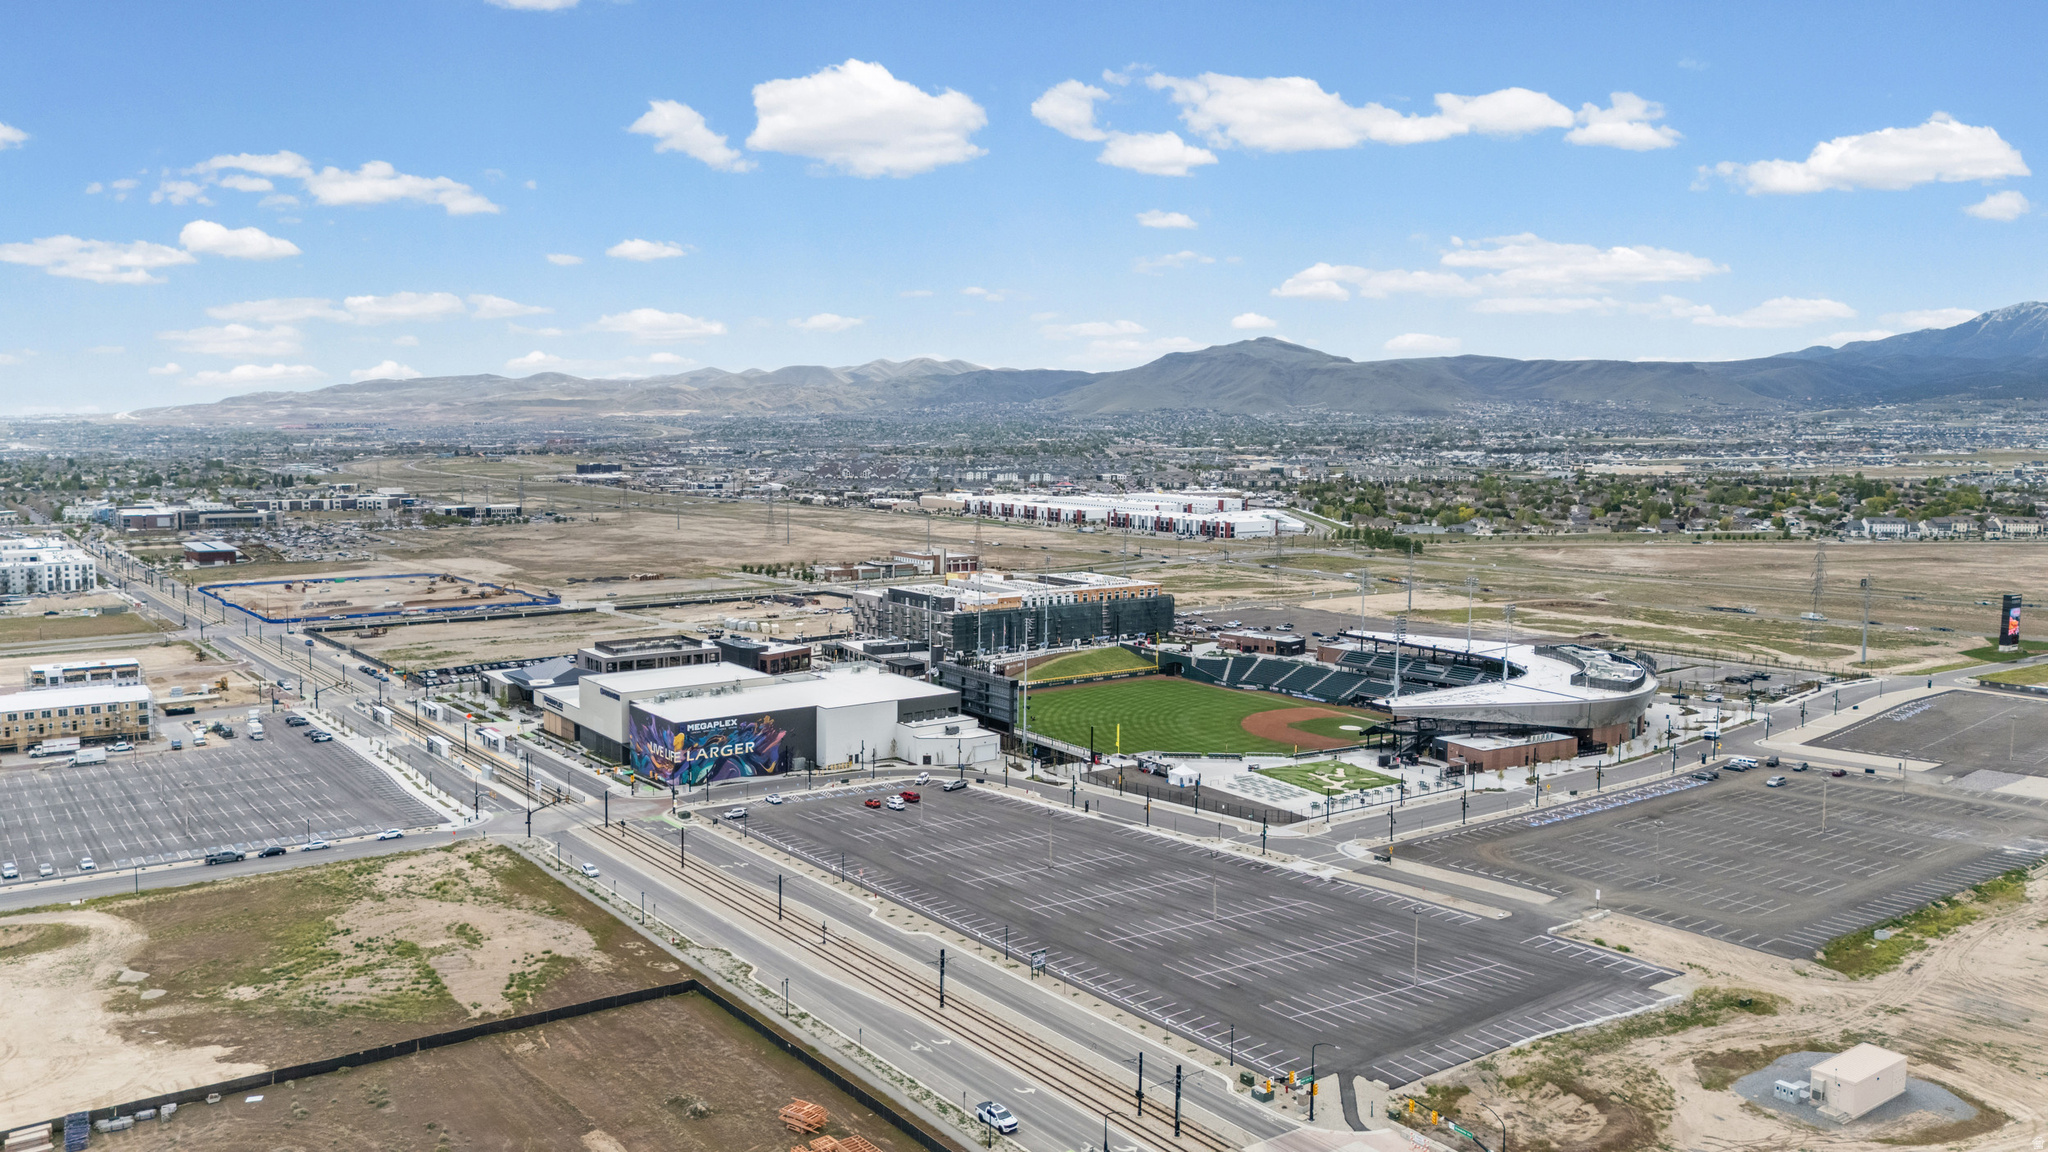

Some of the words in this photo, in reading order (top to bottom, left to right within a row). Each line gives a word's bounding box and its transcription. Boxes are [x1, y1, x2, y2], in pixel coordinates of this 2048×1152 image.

[687, 718, 738, 732] MEGAPLEX
[650, 741, 664, 758] LIVE
[664, 748, 682, 764] LIFE
[686, 741, 755, 762] LARGER
